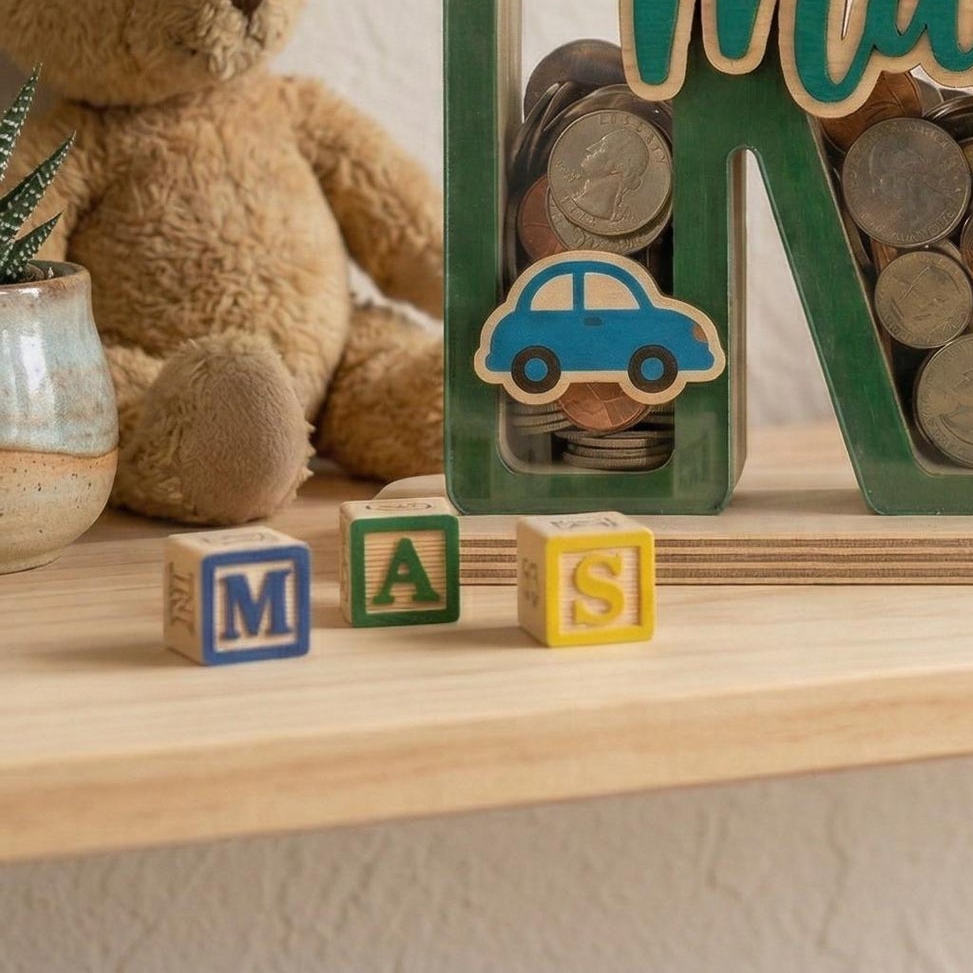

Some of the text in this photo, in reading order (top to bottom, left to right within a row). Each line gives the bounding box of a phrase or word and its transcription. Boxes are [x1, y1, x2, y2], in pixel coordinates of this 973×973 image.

[219, 569, 294, 640] M
[372, 537, 440, 604] A
[573, 553, 625, 625] S
